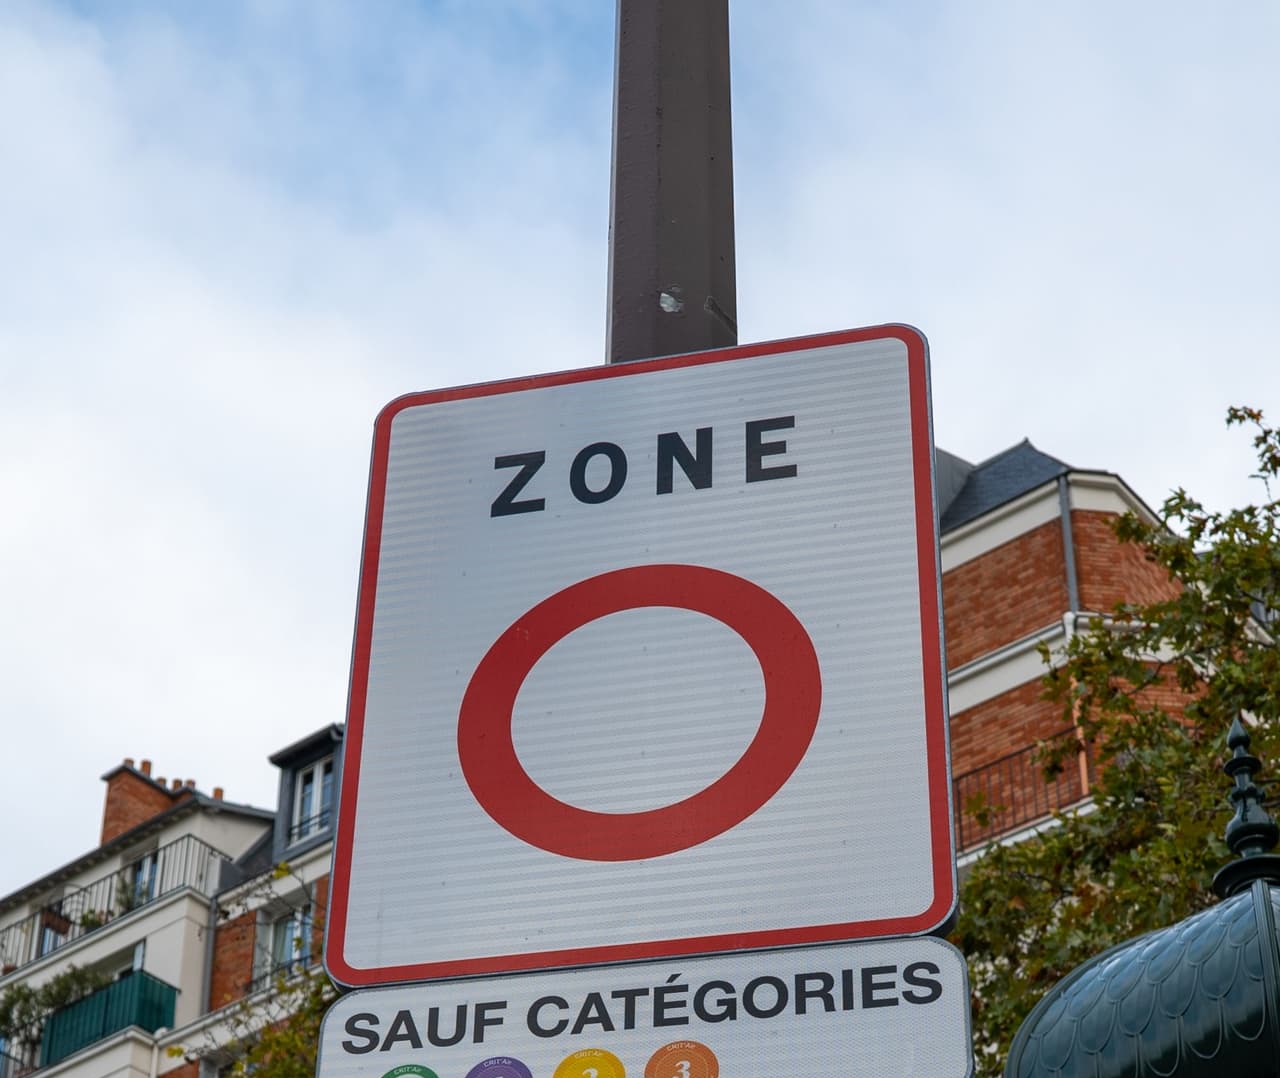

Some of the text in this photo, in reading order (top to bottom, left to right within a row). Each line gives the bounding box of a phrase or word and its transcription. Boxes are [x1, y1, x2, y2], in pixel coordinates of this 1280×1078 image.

[489, 414, 799, 518] ZONE
[341, 961, 943, 1055] SAUF CATÉGORIES
